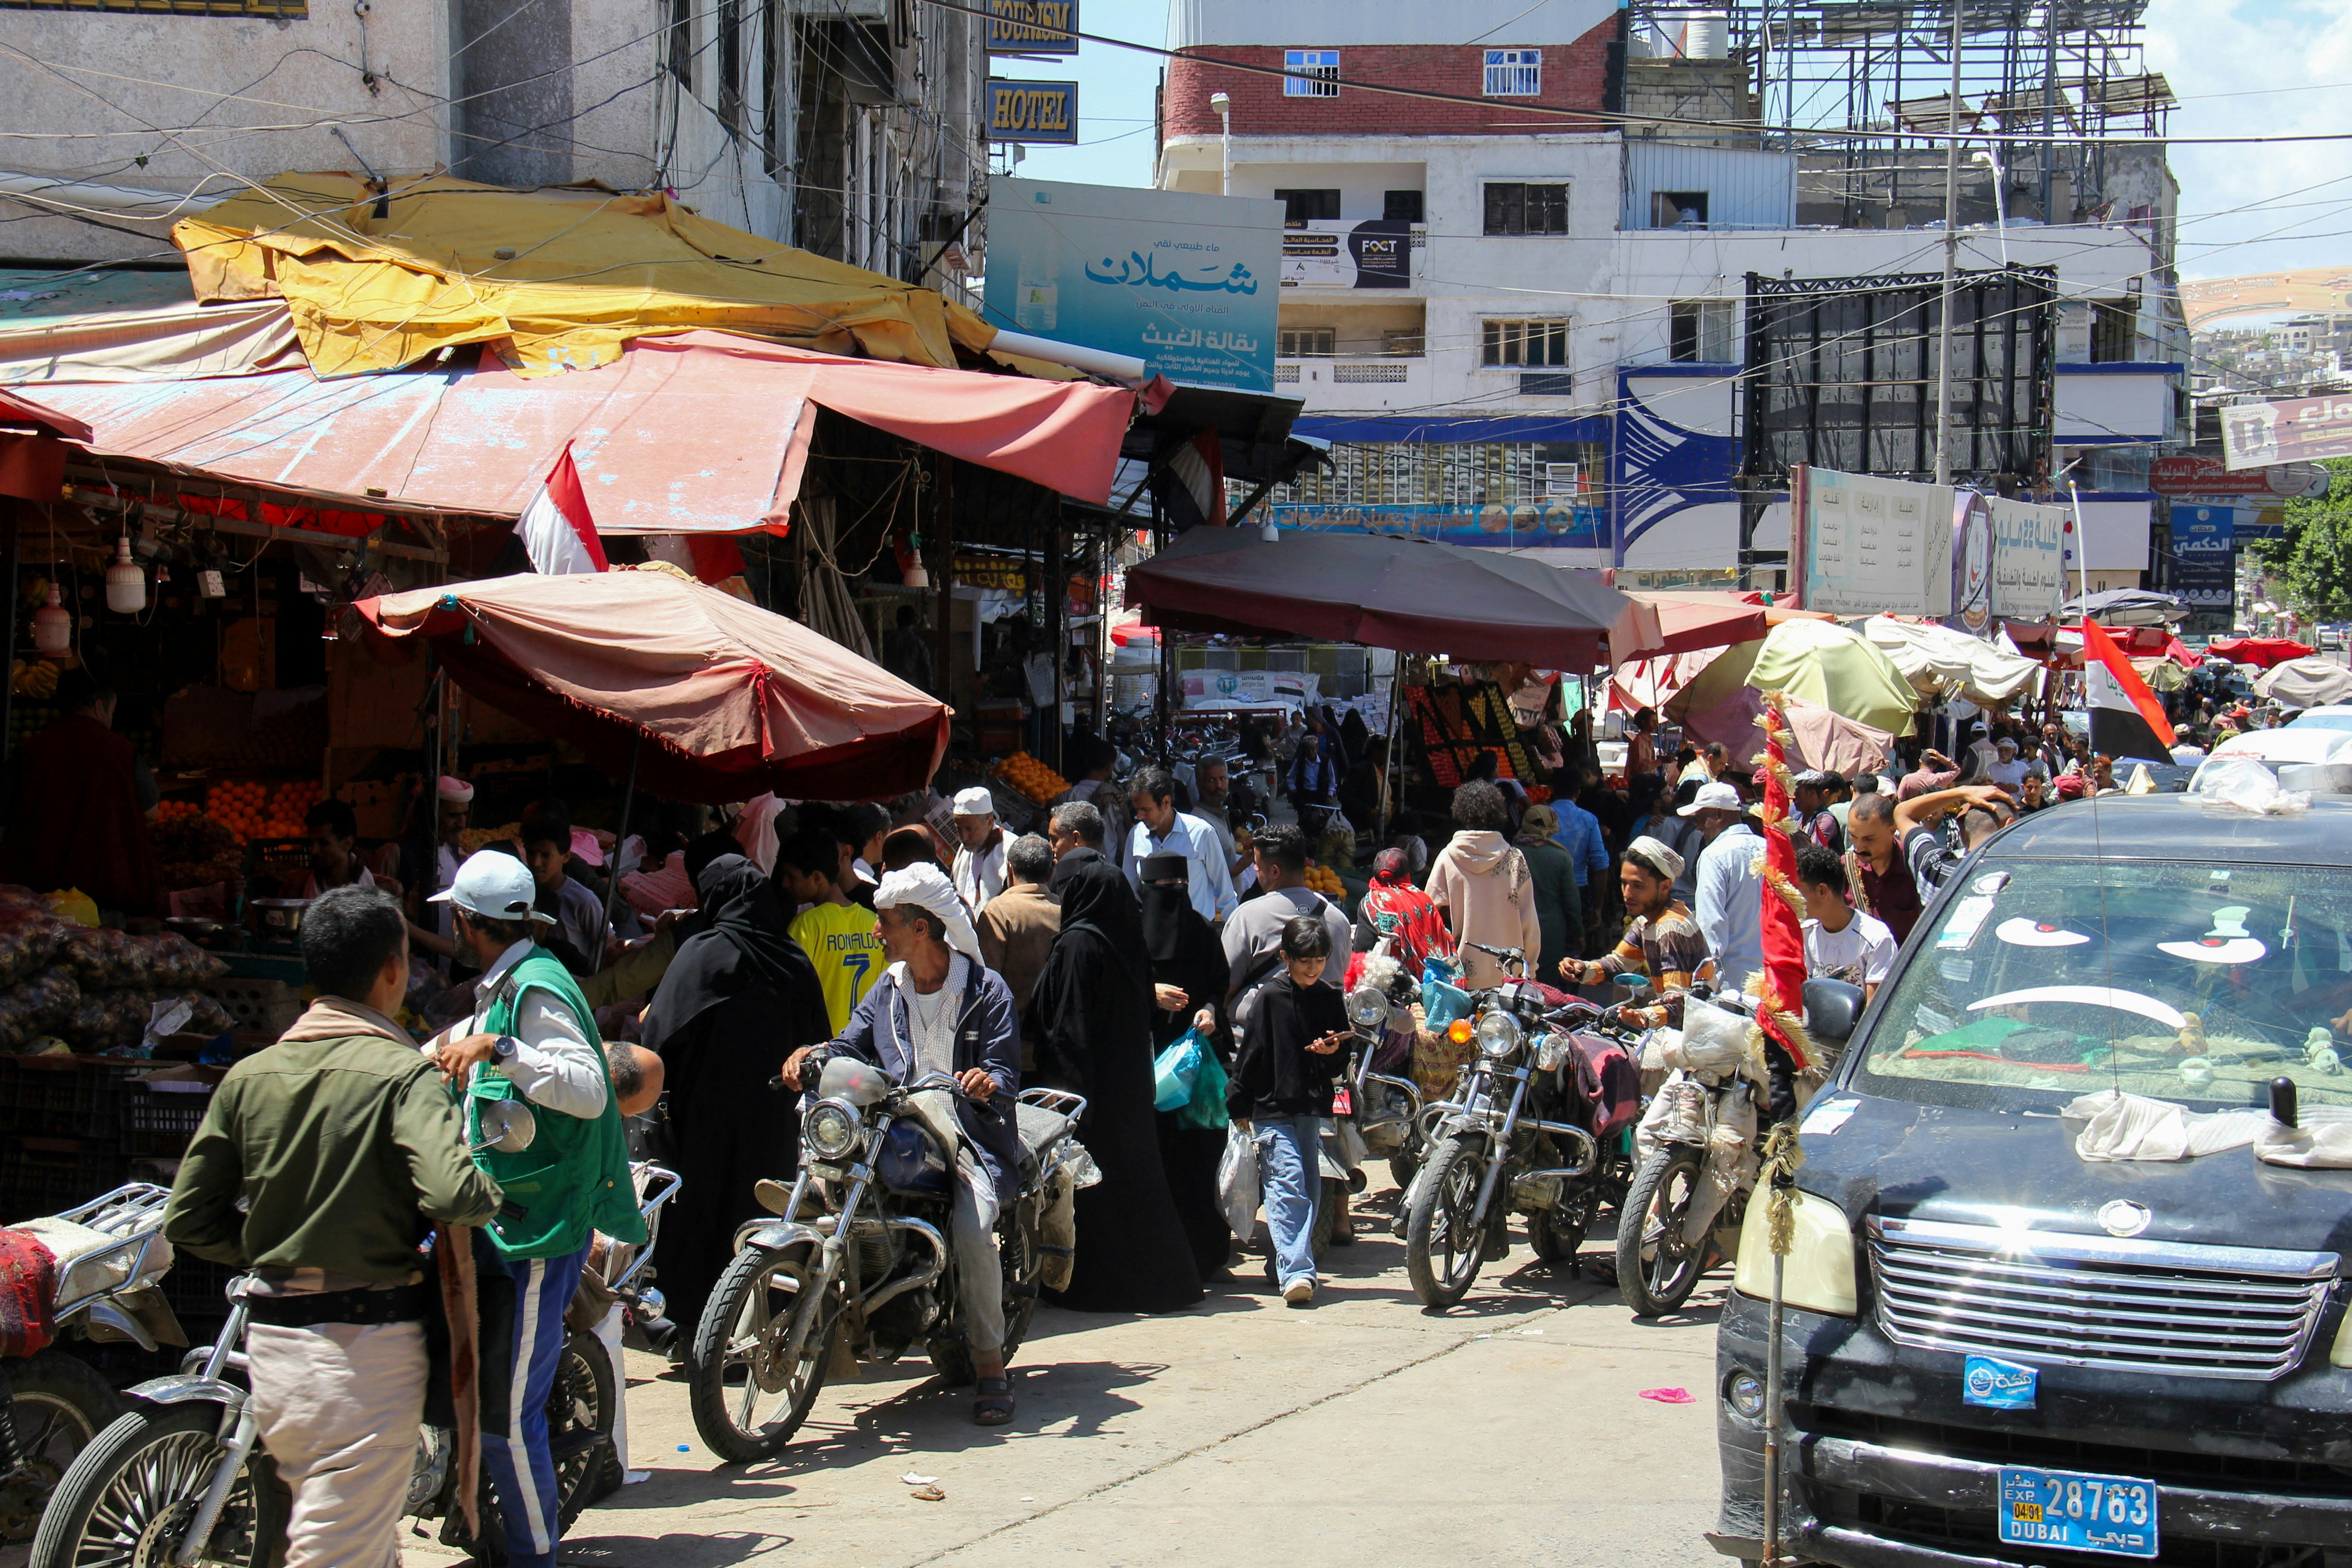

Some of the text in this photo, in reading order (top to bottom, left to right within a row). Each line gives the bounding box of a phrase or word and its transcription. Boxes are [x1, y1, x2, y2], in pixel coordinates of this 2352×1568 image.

[992, 89, 1068, 129] HOTEL
[1154, 240, 1219, 252] ماء طبيعي نقي
[1136, 299, 1157, 309] اليمن
[1206, 306, 1229, 314] المياه
[1142, 323, 1257, 358] بقالة الغيث
[1823, 491, 1839, 506] تقنية
[1861, 496, 1879, 513] إدارية
[2035, 511, 2058, 561] كلية
[2173, 536, 2230, 557] الحكمي
[843, 953, 870, 1020] 7
[1995, 1373, 2032, 1389] مكة
[2005, 1477, 2035, 1489] تصدير
[2004, 1489, 2035, 1501] EXP.
[2046, 1478, 2148, 1525] 28763
[2011, 1521, 2068, 1542] DUBAI
[2087, 1529, 2144, 1548] دبي
